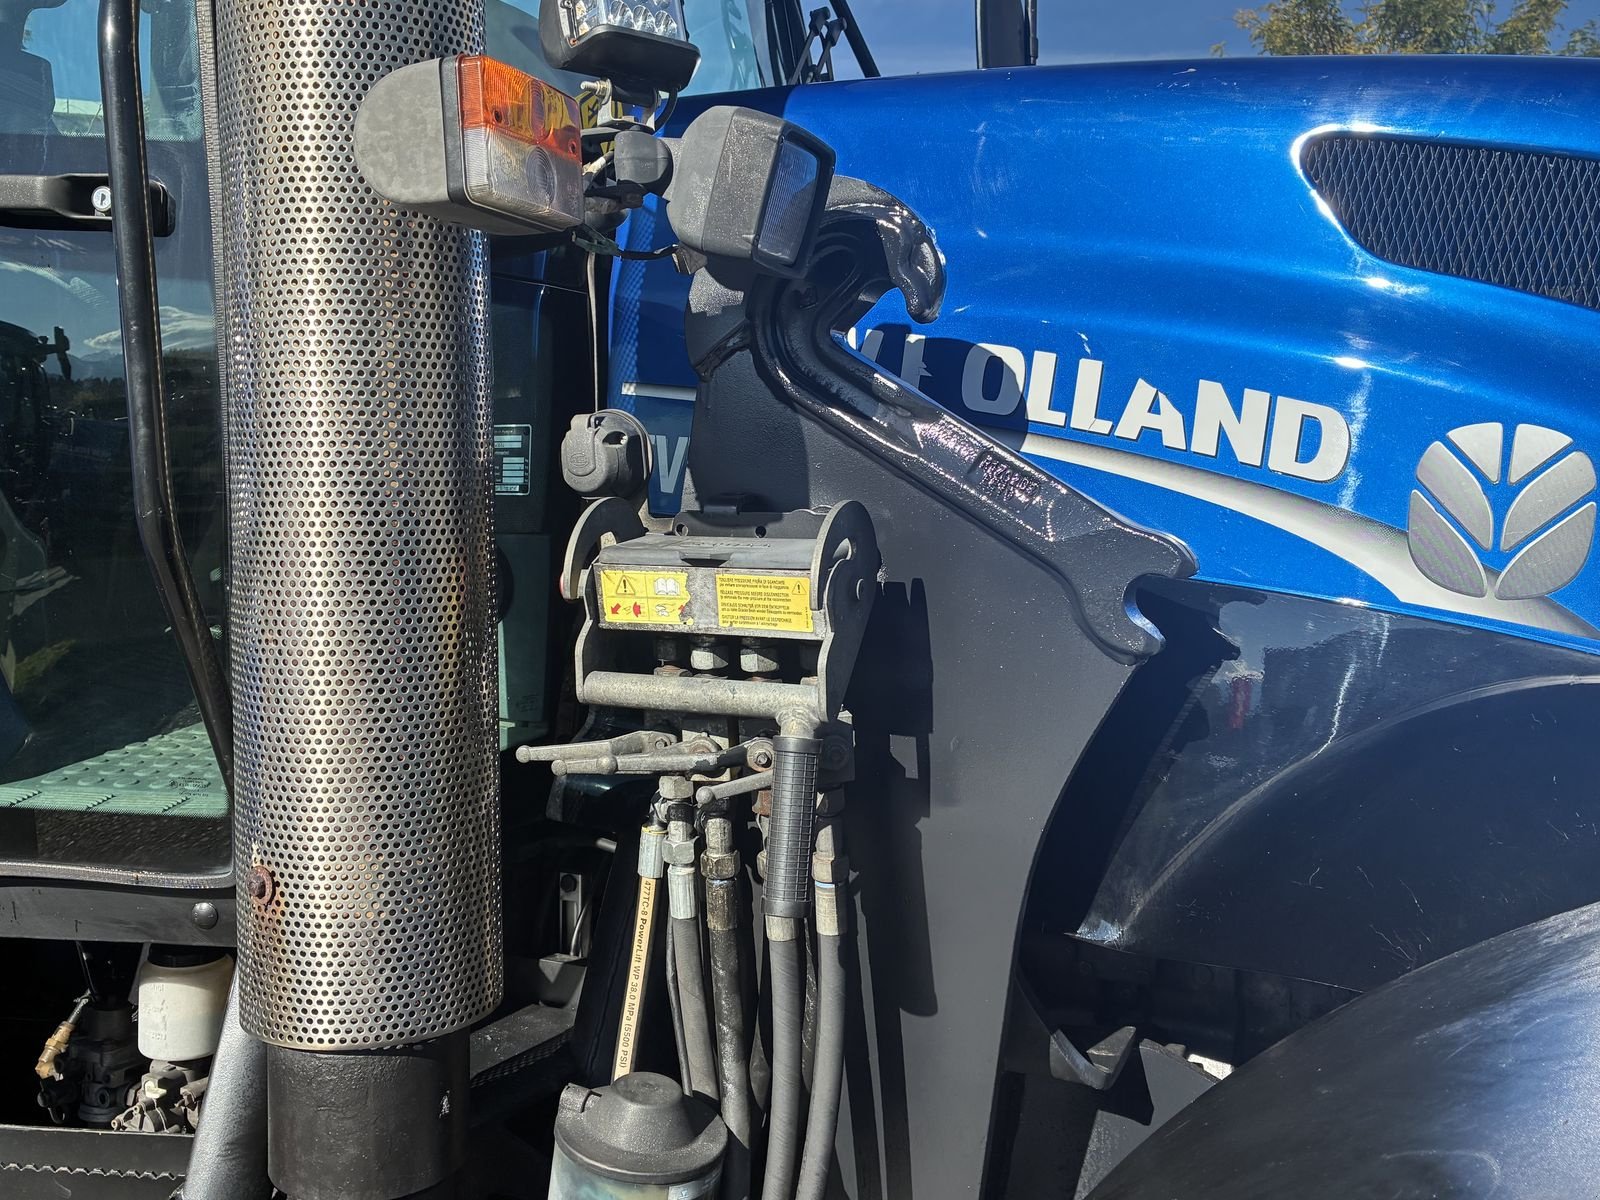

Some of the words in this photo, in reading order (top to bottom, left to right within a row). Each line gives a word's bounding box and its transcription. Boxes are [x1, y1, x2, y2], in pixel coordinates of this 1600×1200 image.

[641, 880, 652, 916] 477TC-8
[635, 917, 647, 963] PowerLift
[633, 965, 641, 980] WP
[629, 982, 638, 1000] 38.0
[626, 1002, 635, 1021] MPa
[622, 1023, 632, 1049] (5500
[619, 1050, 628, 1068] PSI)
